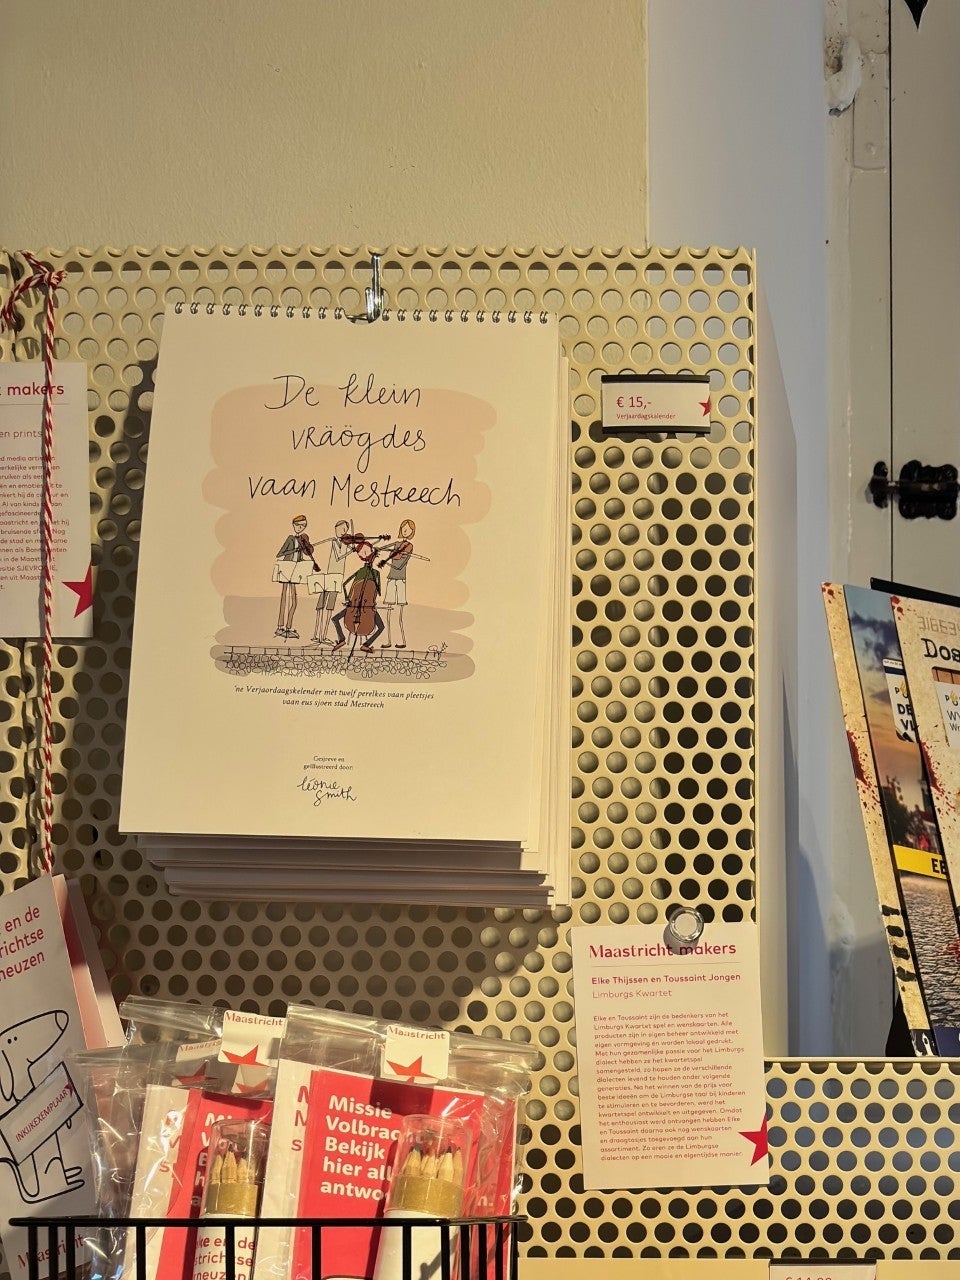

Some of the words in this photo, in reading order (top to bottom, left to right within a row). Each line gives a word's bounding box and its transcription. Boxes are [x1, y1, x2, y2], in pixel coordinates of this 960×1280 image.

[7, 382, 65, 396] makers
[263, 374, 319, 409] De
[616, 396, 624, 408] €
[629, 396, 652, 410] 15,-
[13, 430, 42, 439] prints
[248, 475, 317, 500] vaan
[330, 473, 461, 508] Mestreech
[334, 699, 349, 707] stad
[350, 699, 384, 708] Mestreech
[4, 917, 21, 932] en
[25, 906, 40, 923] de
[589, 943, 673, 958] Maastricht
[679, 941, 737, 956] makers
[591, 977, 611, 985] Elke
[612, 976, 649, 986] Thijssen
[663, 974, 707, 983] Toussaint
[708, 973, 741, 984] Jongen
[592, 990, 634, 1000] Limburgs
[635, 989, 673, 998] Kwartet
[225, 1011, 284, 1027] Maastricht
[387, 1025, 447, 1041] Maastricht
[329, 1094, 392, 1120] Missie
[325, 1137, 385, 1163] Bekijk
[323, 1156, 363, 1176] hier
[320, 1181, 392, 1201] antwo
